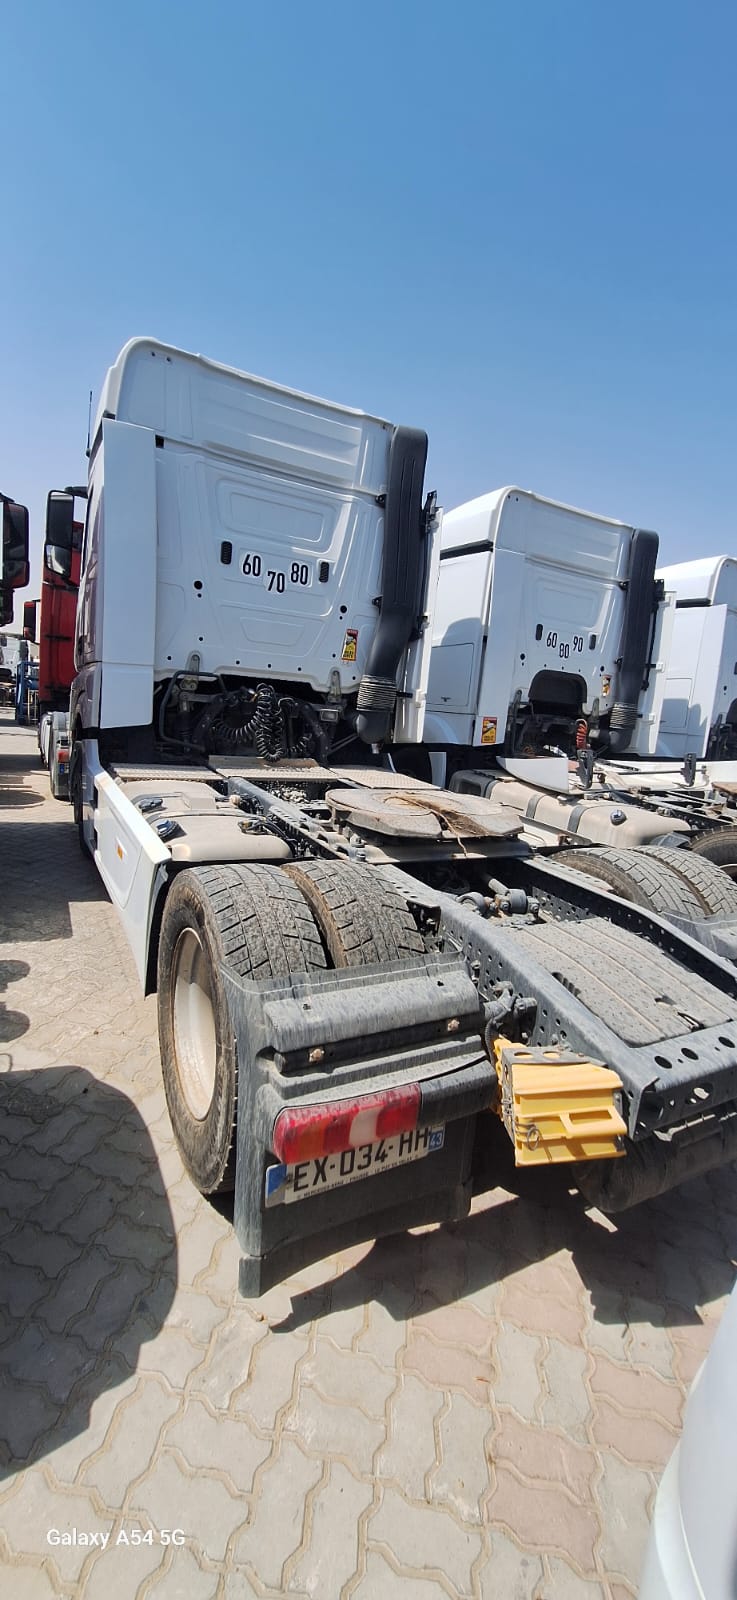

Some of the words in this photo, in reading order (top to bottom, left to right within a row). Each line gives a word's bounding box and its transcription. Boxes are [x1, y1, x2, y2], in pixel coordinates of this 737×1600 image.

[242, 554, 261, 577] 60
[267, 570, 285, 593] 70
[290, 562, 308, 585] 80
[546, 631, 558, 649] 60
[559, 642, 570, 659] 80
[573, 635, 584, 652] 90
[429, 1132, 443, 1147] 43
[293, 1127, 429, 1192] EX-034-HH
